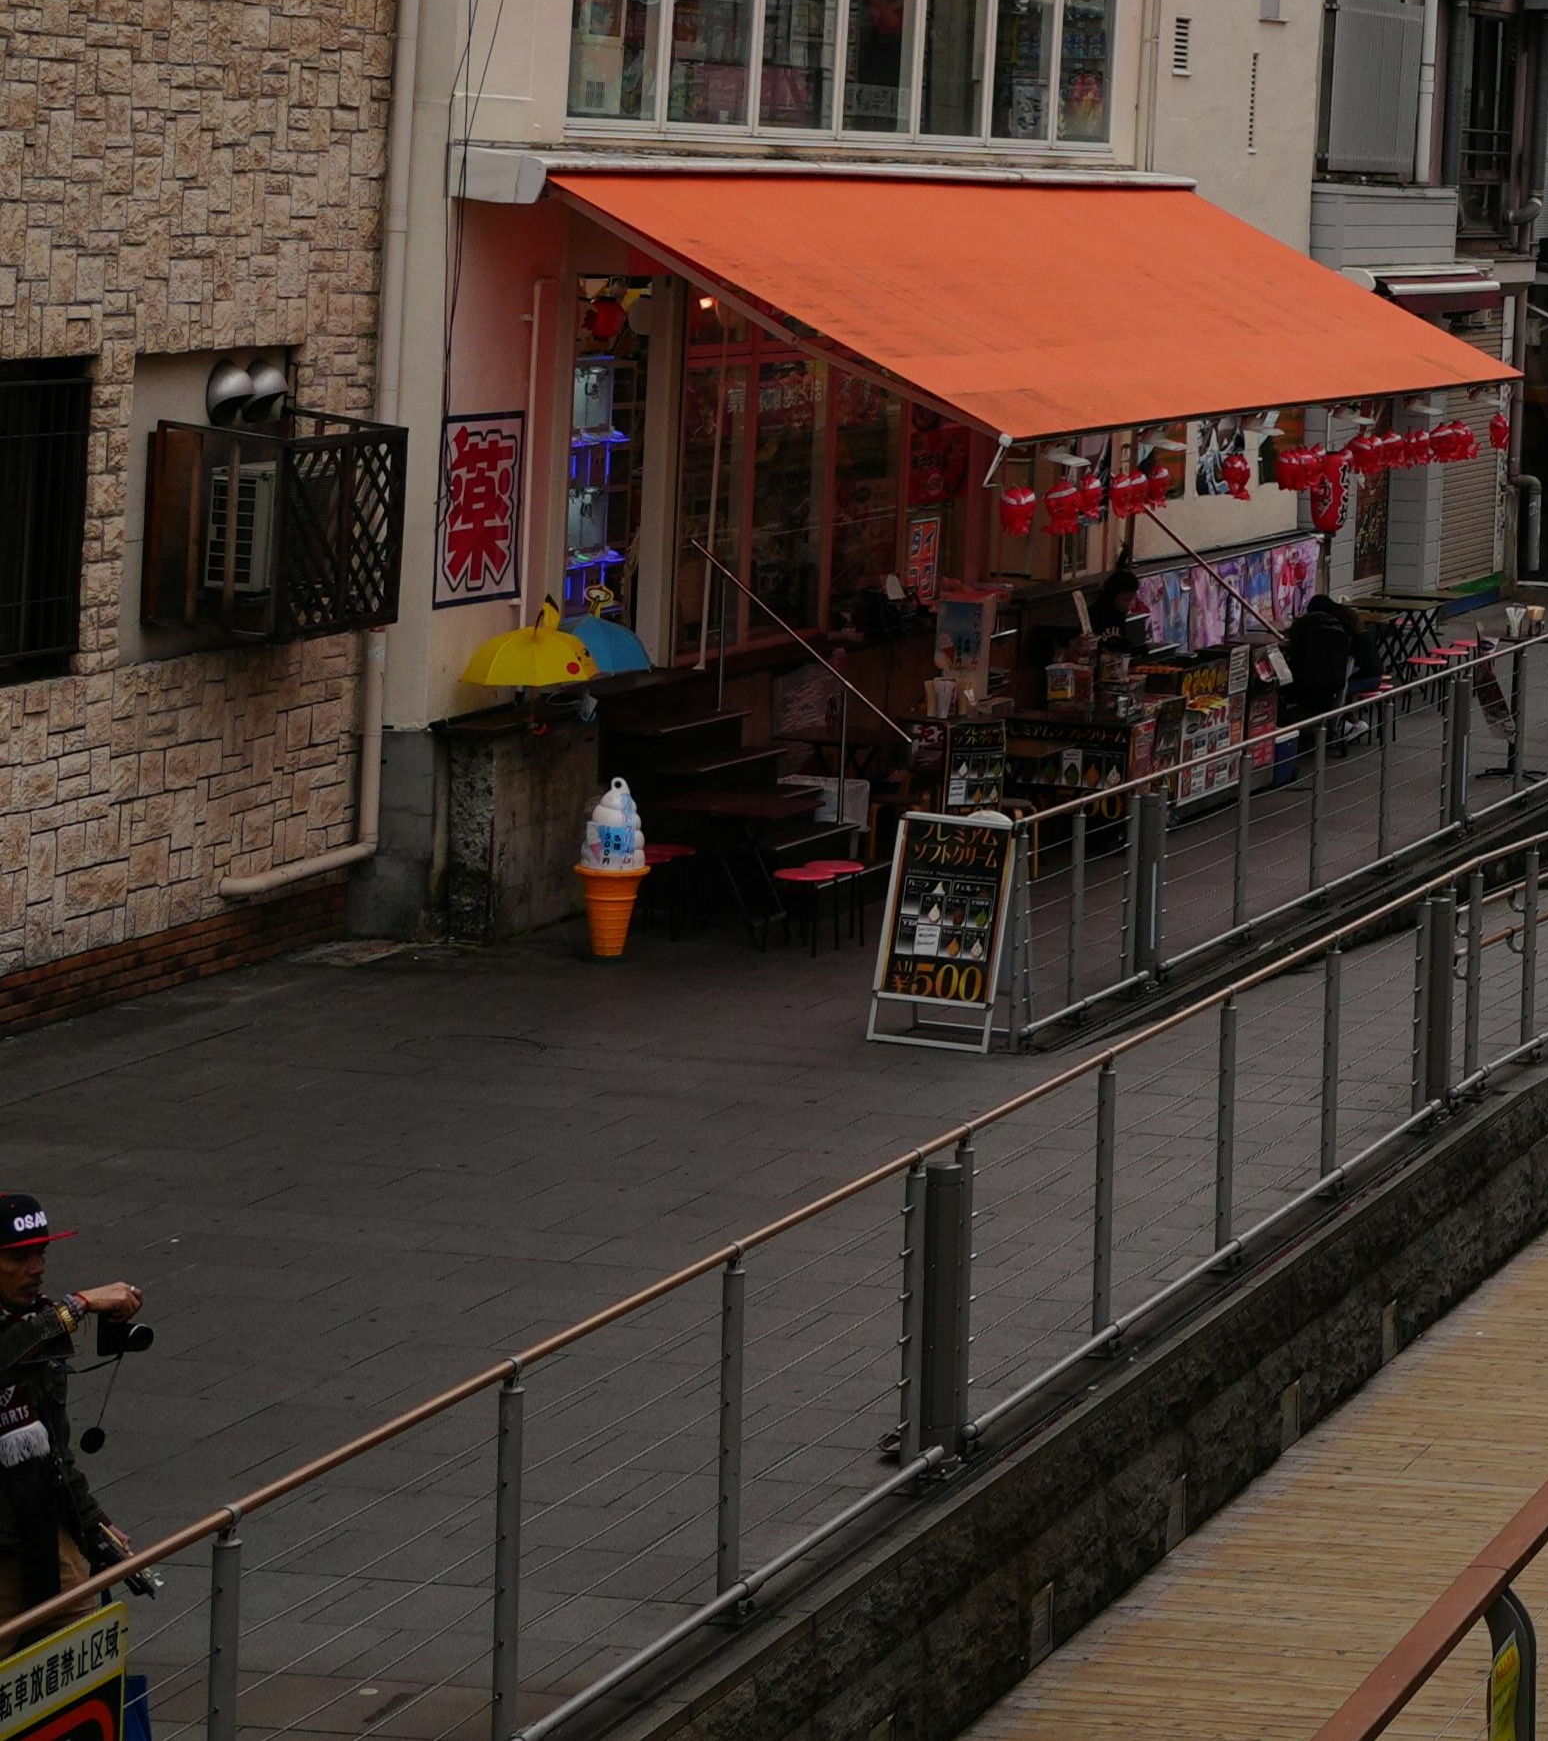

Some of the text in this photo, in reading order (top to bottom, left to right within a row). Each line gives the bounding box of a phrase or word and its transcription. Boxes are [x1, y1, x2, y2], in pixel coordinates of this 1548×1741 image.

[443, 424, 516, 591] 薬
[911, 845, 996, 869] ソフトクリーム
